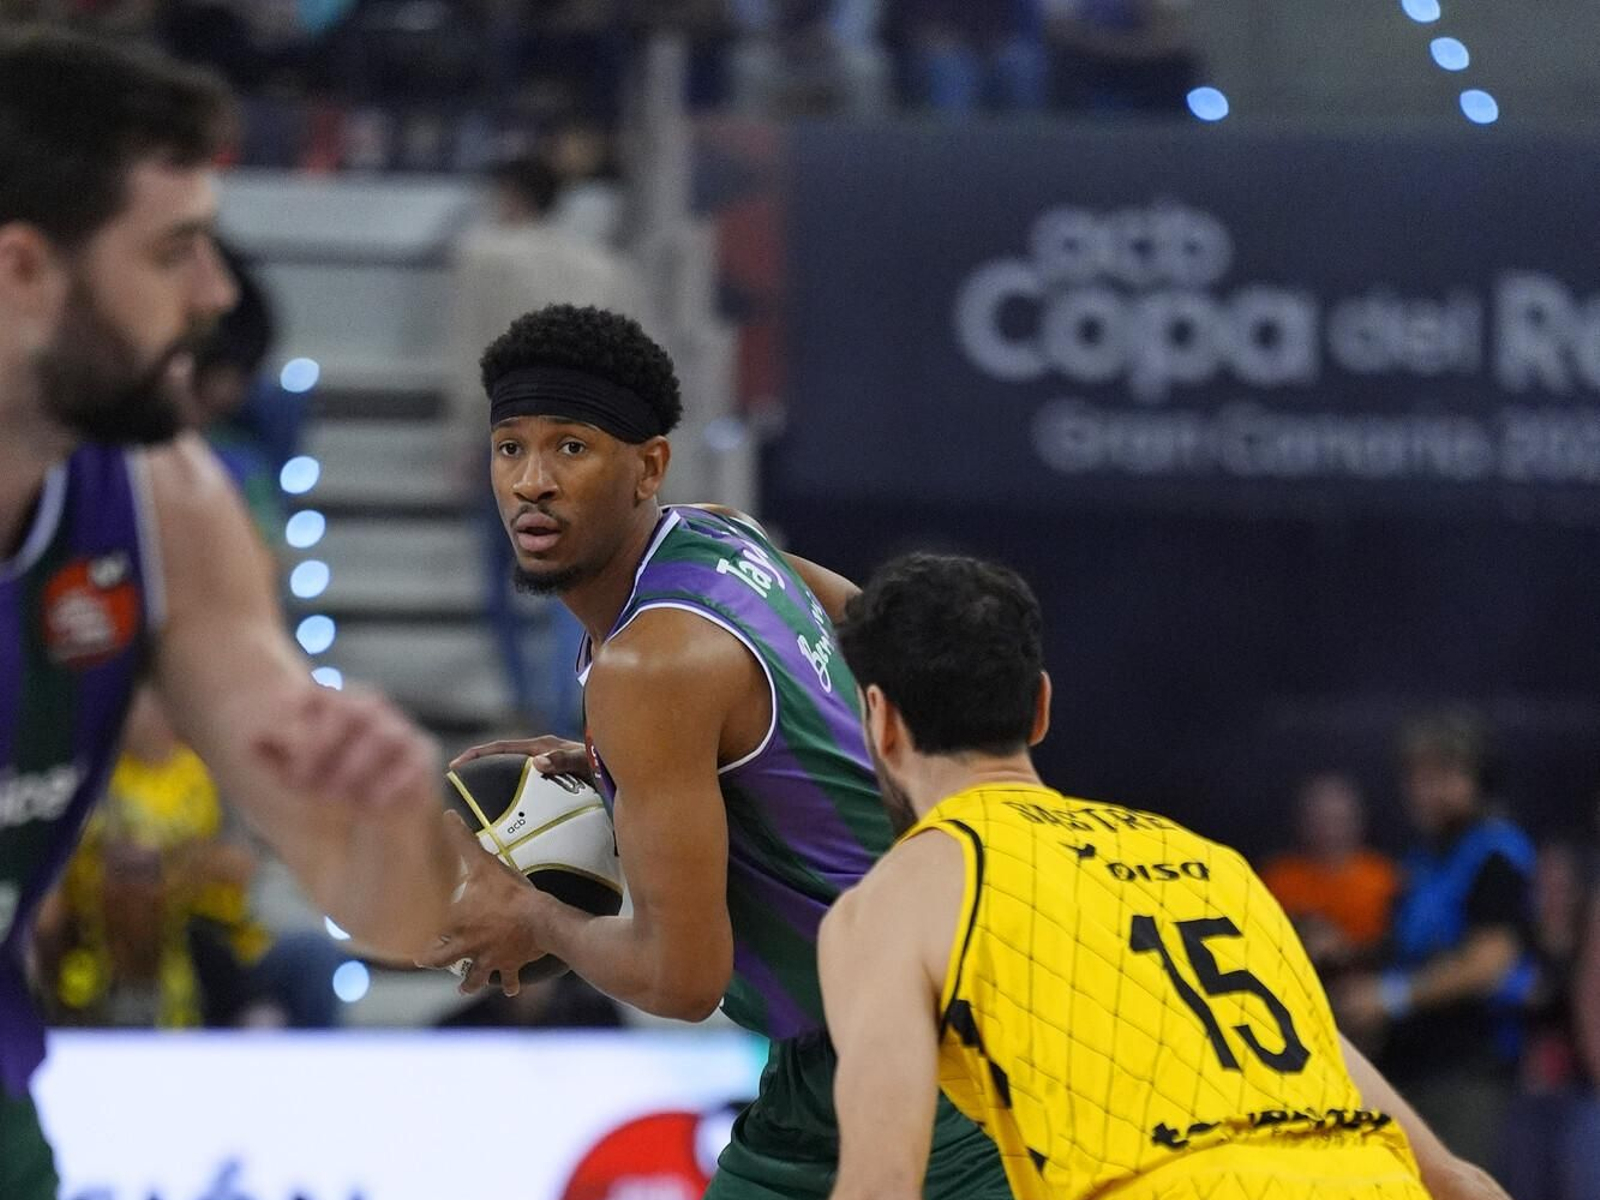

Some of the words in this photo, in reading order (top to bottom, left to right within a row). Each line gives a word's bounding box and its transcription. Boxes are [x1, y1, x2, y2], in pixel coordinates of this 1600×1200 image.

[960, 262, 1318, 400] Copa
[507, 818, 526, 834] acb
[1130, 915, 1311, 1075] 15
